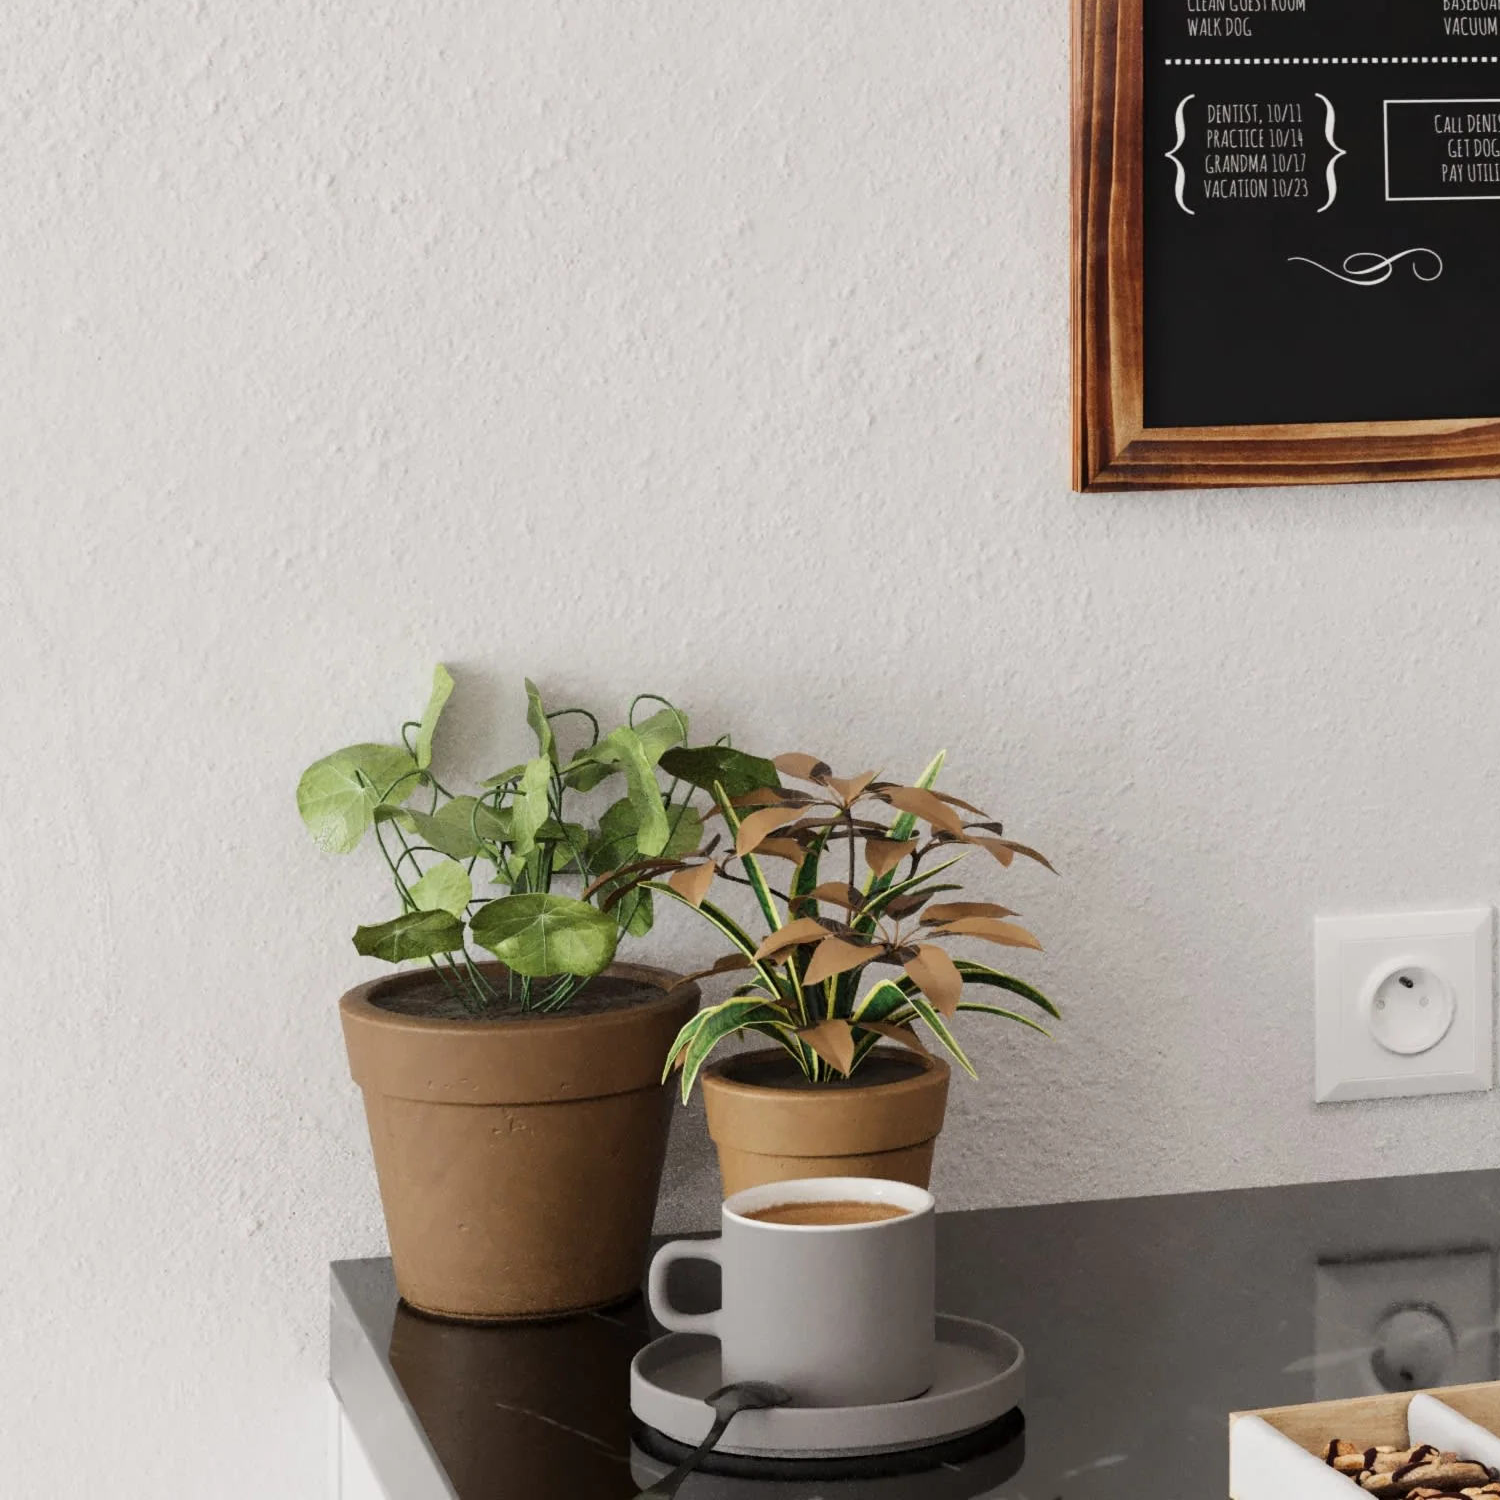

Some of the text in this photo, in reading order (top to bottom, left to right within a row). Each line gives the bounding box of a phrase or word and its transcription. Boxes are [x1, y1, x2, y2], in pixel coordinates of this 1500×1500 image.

[1187, 16, 1253, 37] WALK DOG
[1443, 16, 1498, 36] VACUUM
[1207, 103, 1303, 125] DENTIST, 10/11
[1434, 114, 1464, 134] CALL
[1206, 128, 1304, 149] PRACTICE 10/14
[1447, 138, 1470, 158] GET
[1473, 138, 1500, 158] DOG
[1204, 152, 1306, 174] GRANDMA 10/17
[1441, 163, 1463, 183] PAY
[1203, 177, 1309, 199] VACATION 10/23
